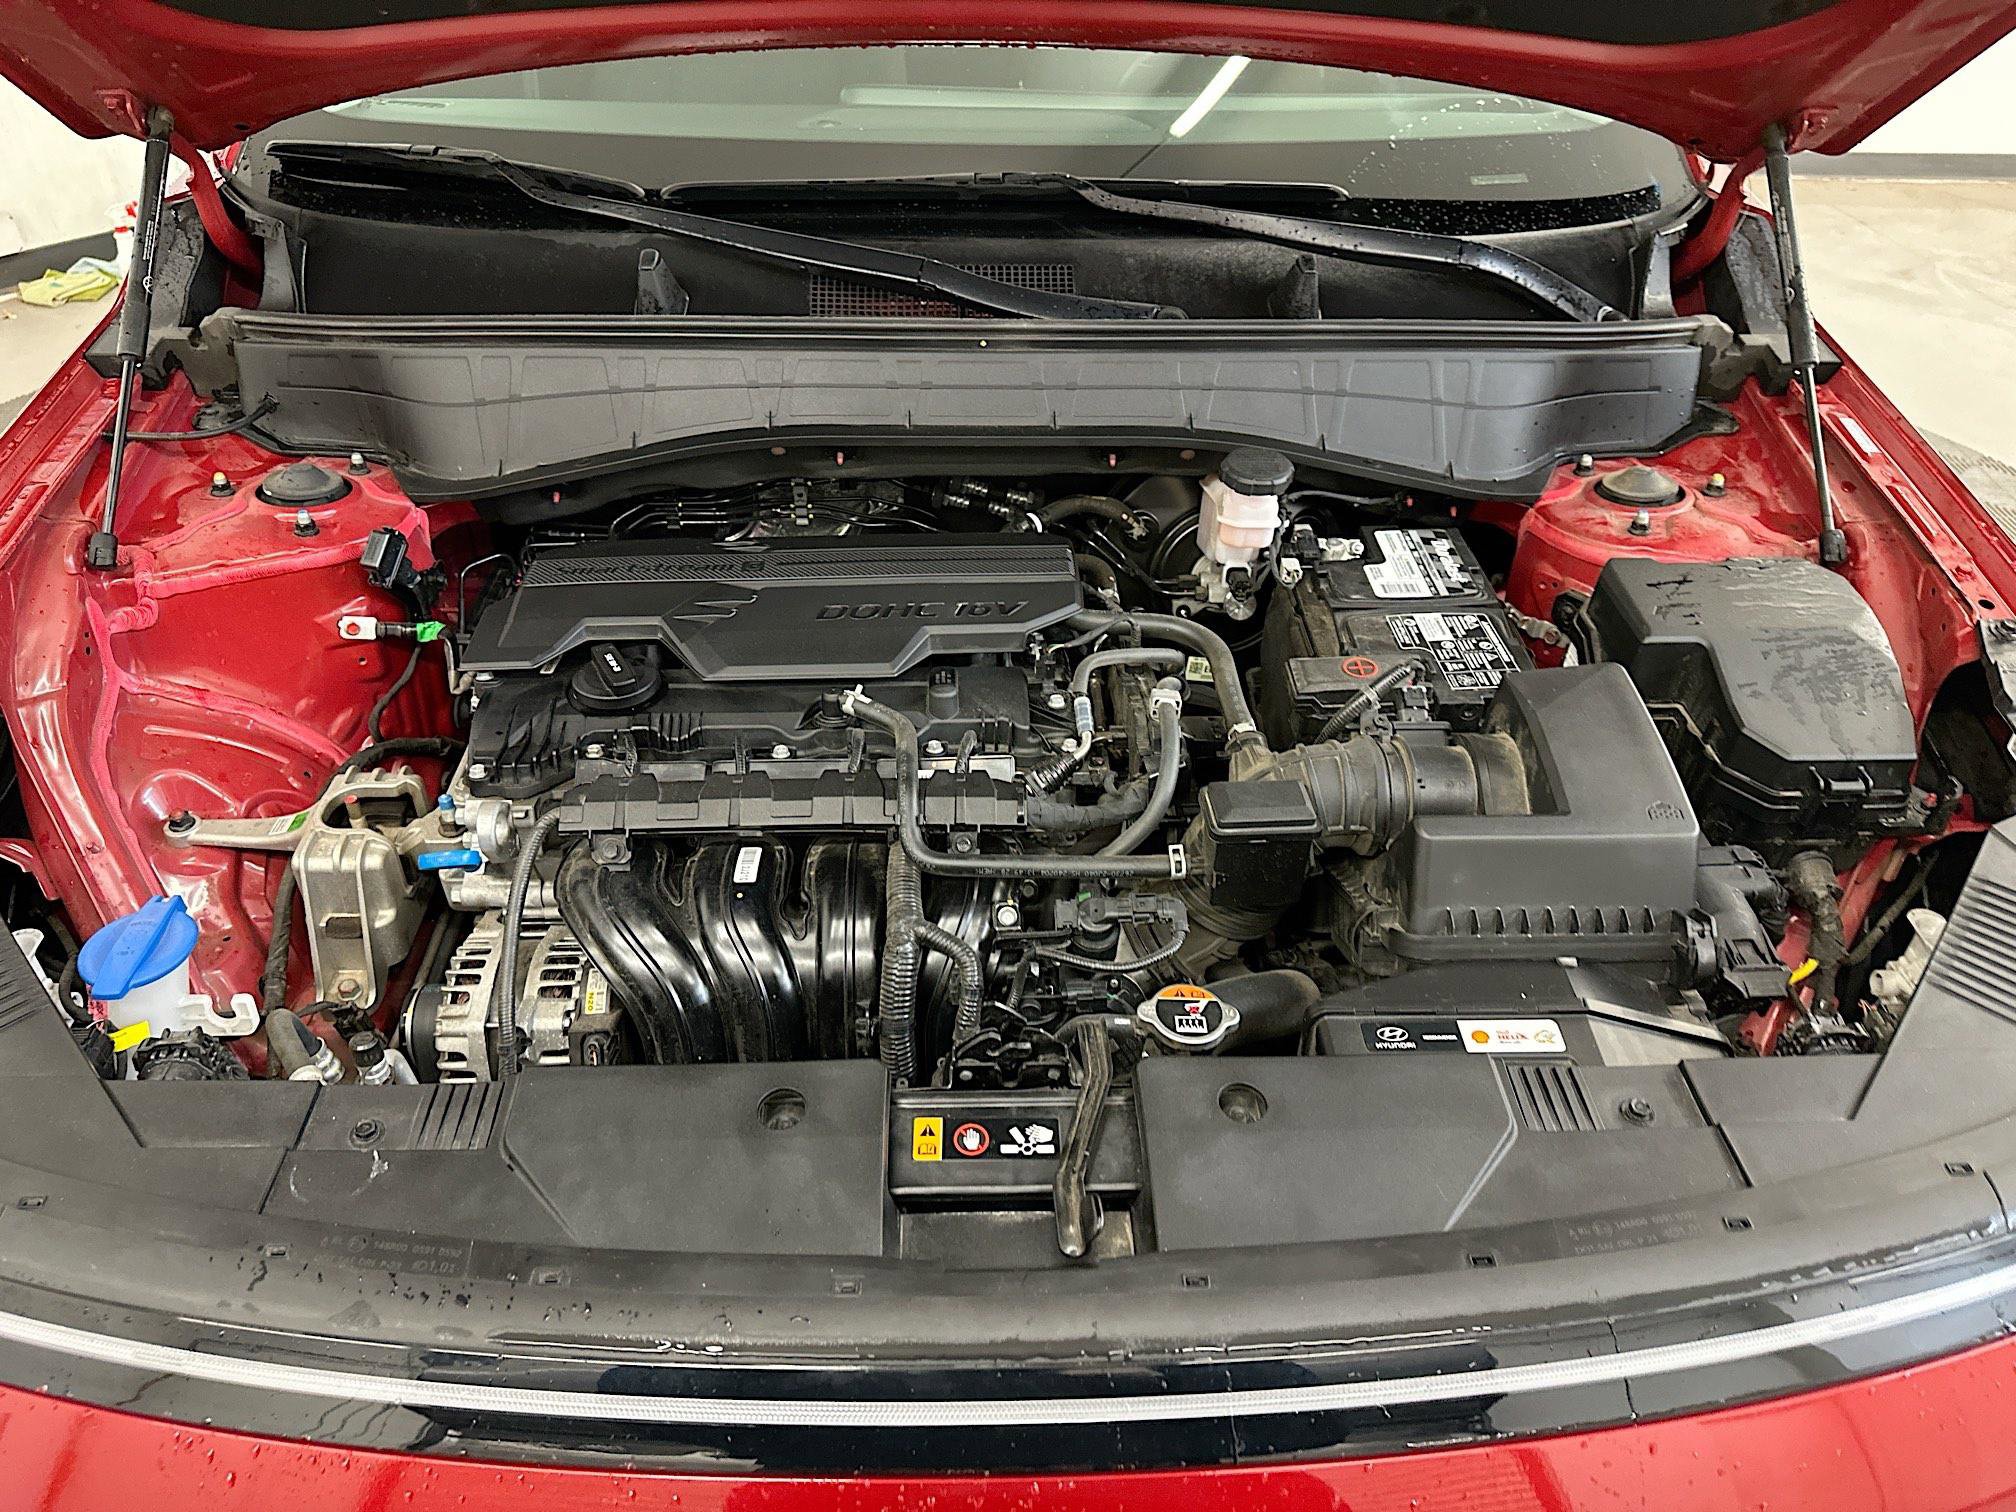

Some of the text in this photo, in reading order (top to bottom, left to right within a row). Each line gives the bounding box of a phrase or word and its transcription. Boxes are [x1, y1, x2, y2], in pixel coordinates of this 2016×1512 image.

[815, 600, 1029, 621] DOHC 16V
[1375, 1041, 1417, 1050] HYUNDAI
